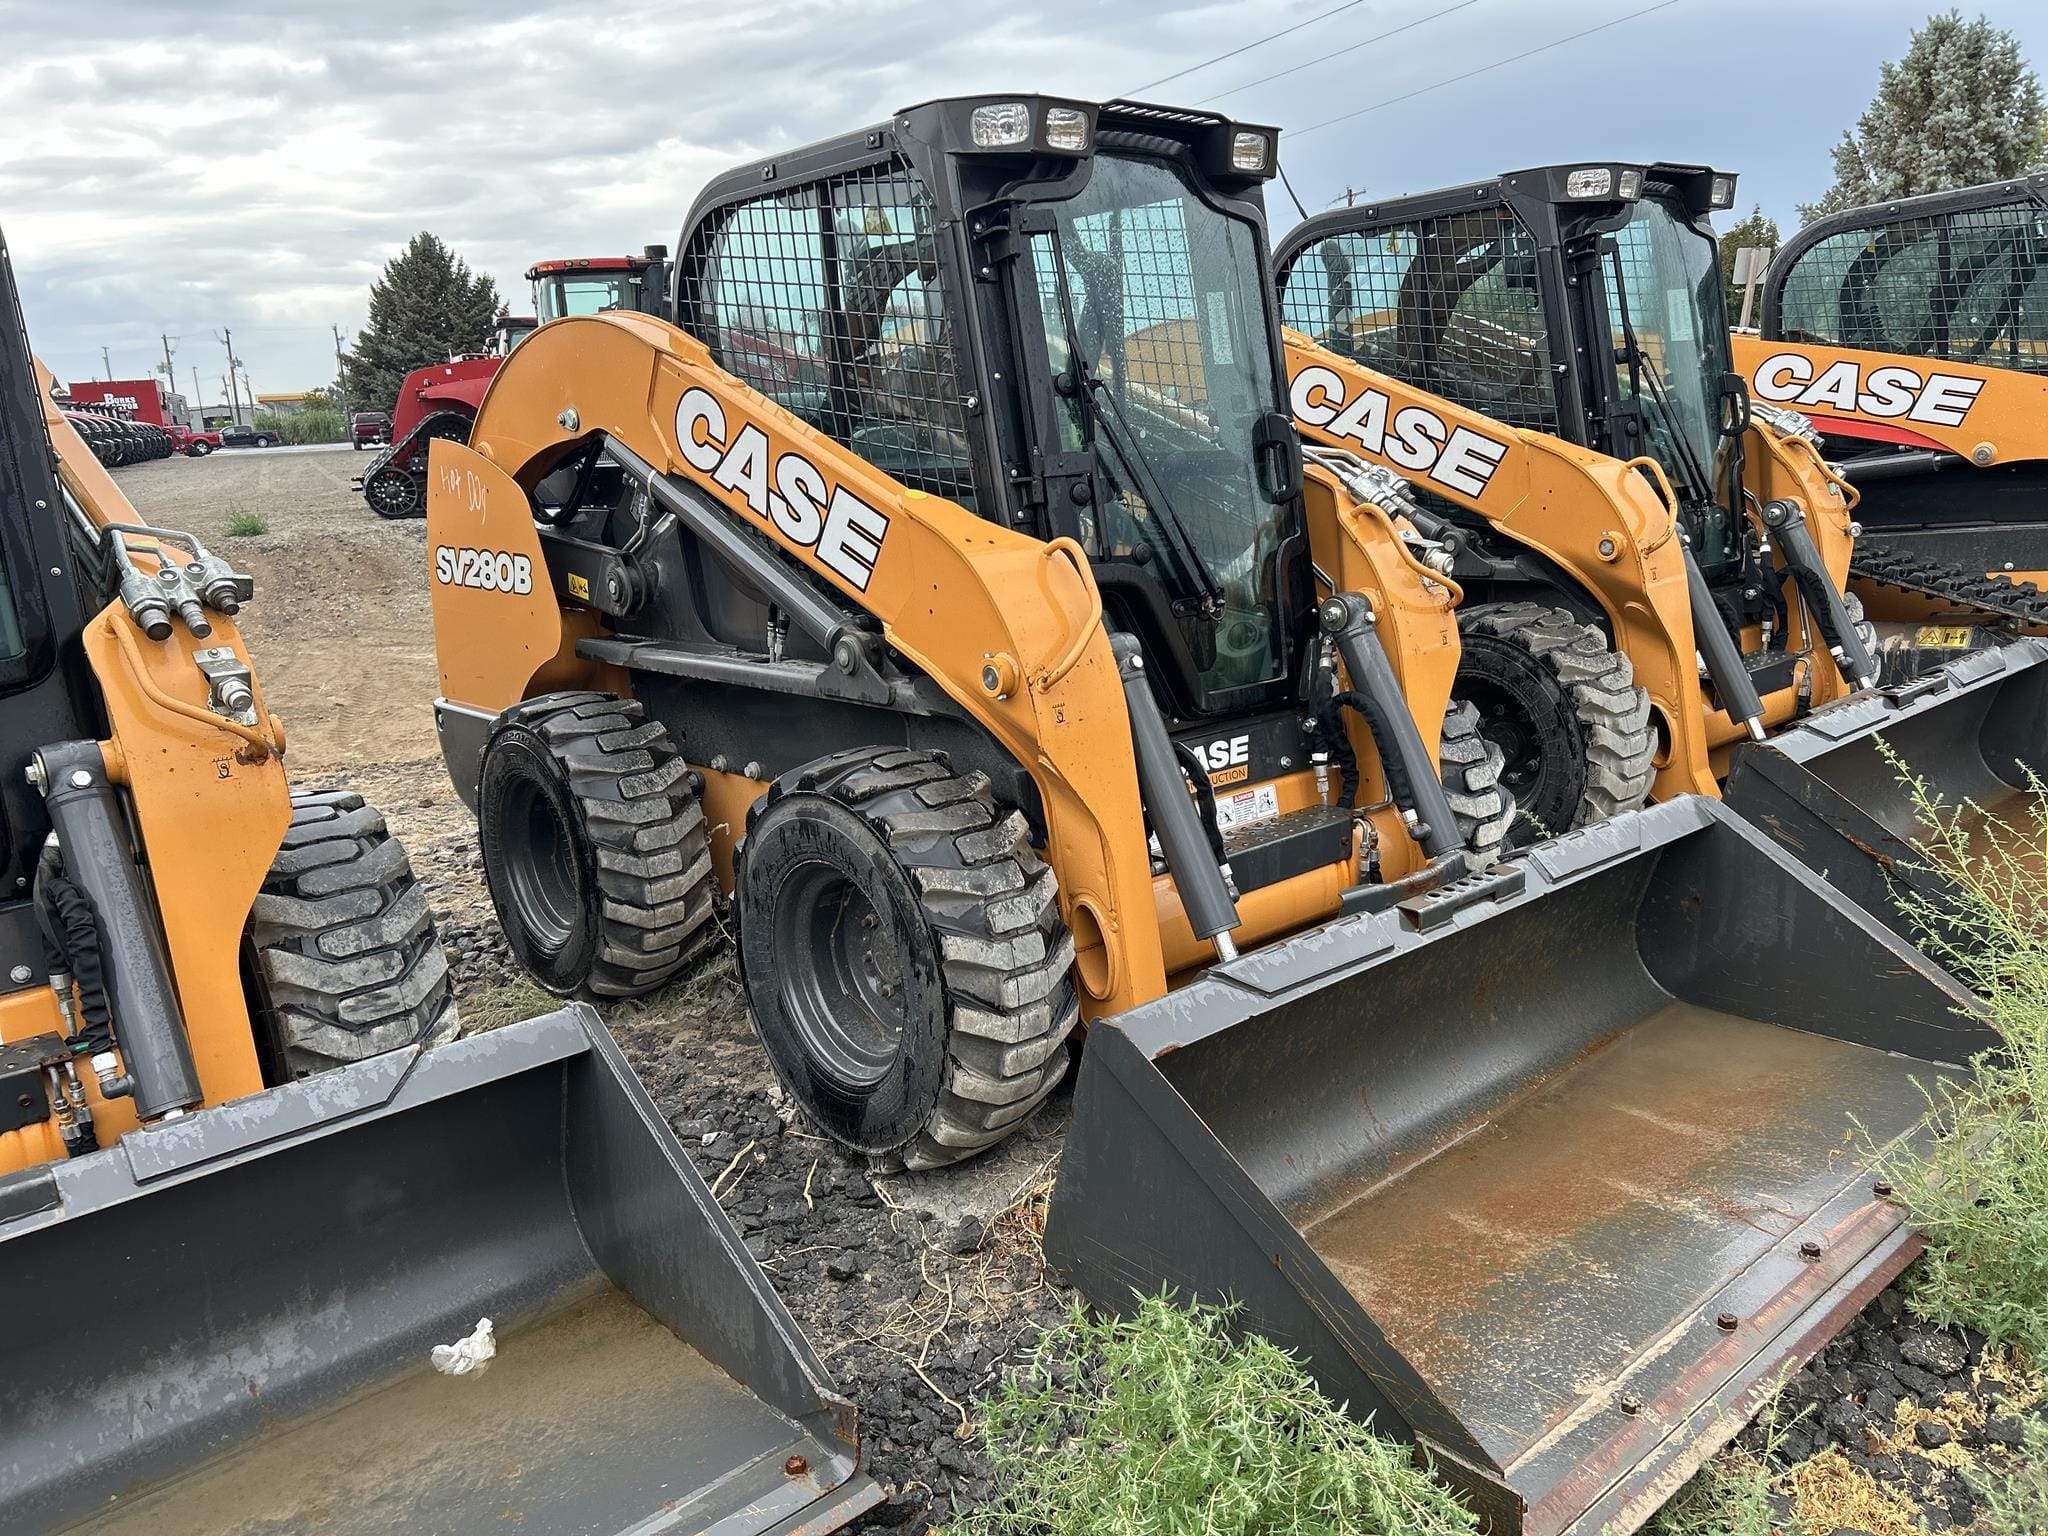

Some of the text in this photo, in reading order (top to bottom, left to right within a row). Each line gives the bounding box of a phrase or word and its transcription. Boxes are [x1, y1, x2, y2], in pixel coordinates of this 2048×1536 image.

[1752, 352, 1987, 428] CASE
[1290, 365, 1510, 500] CASE
[675, 386, 891, 594] CASE
[436, 545, 532, 595] SV280B
[1190, 735, 1249, 771] ASE
